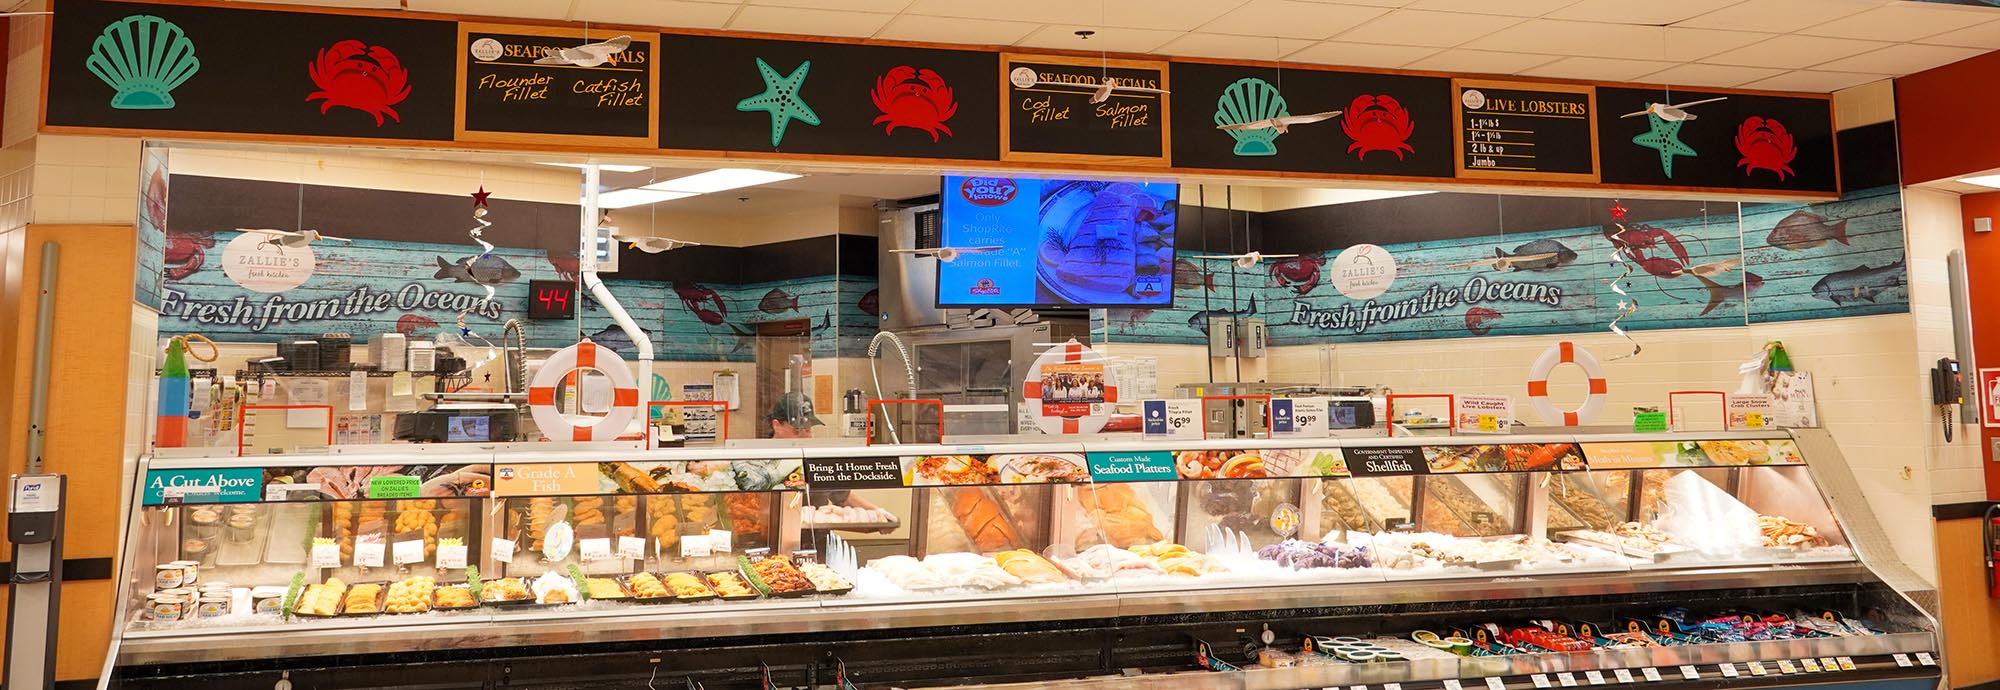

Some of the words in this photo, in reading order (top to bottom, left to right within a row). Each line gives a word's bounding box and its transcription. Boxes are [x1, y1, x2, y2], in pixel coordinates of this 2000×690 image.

[504, 44, 566, 59] SEAFO
[478, 73, 554, 89] Flounder
[572, 78, 640, 94] Catfish
[1039, 72, 1096, 85] SEAFOOD
[503, 86, 547, 102] Fillet
[597, 92, 643, 108] Fillet
[1022, 96, 1050, 110] Cod
[1096, 102, 1147, 118] Salmon
[1486, 98, 1517, 112] LIVE
[1521, 100, 1585, 115] LOBSTERS
[1031, 107, 1070, 123] Fillet
[1111, 113, 1148, 129] Fillet
[1472, 143, 1478, 153] 2
[1480, 143, 1487, 153] lb
[1495, 146, 1504, 156] up
[1472, 155, 1496, 167] Jumbo
[972, 178, 999, 188] Did
[976, 212, 1001, 224] Only
[962, 224, 1012, 235] ShopRite
[969, 237, 1005, 245] carries
[239, 255, 300, 268] ZALLIE'S
[951, 258, 991, 268] Salmon
[1342, 266, 1384, 278] ZALLIE'S
[1145, 283, 1153, 291] A
[539, 289, 569, 311] 44
[1292, 300, 1356, 330] Fresh
[1354, 299, 1419, 333] from
[1420, 285, 1459, 310] the
[1463, 276, 1561, 306] Oceans
[160, 287, 253, 325] Fresh
[252, 295, 338, 332] from
[345, 286, 389, 313] the
[396, 283, 502, 320] Oceans
[1134, 455, 1151, 463] Made
[517, 466, 560, 479] Grade
[564, 465, 576, 479] A
[809, 463, 834, 474] Bring
[836, 464, 843, 472] It
[845, 463, 874, 472] Home
[876, 462, 898, 471] Fresh
[1094, 463, 1133, 474] Seafood
[1135, 461, 1171, 474] Platters
[1366, 460, 1413, 473] Shellfish
[150, 476, 164, 489] A
[170, 475, 201, 488] Cut
[205, 474, 255, 488] Above
[813, 473, 835, 482] from
[837, 473, 851, 481] the
[854, 471, 896, 481] Dockside.
[533, 480, 560, 492] Fish
